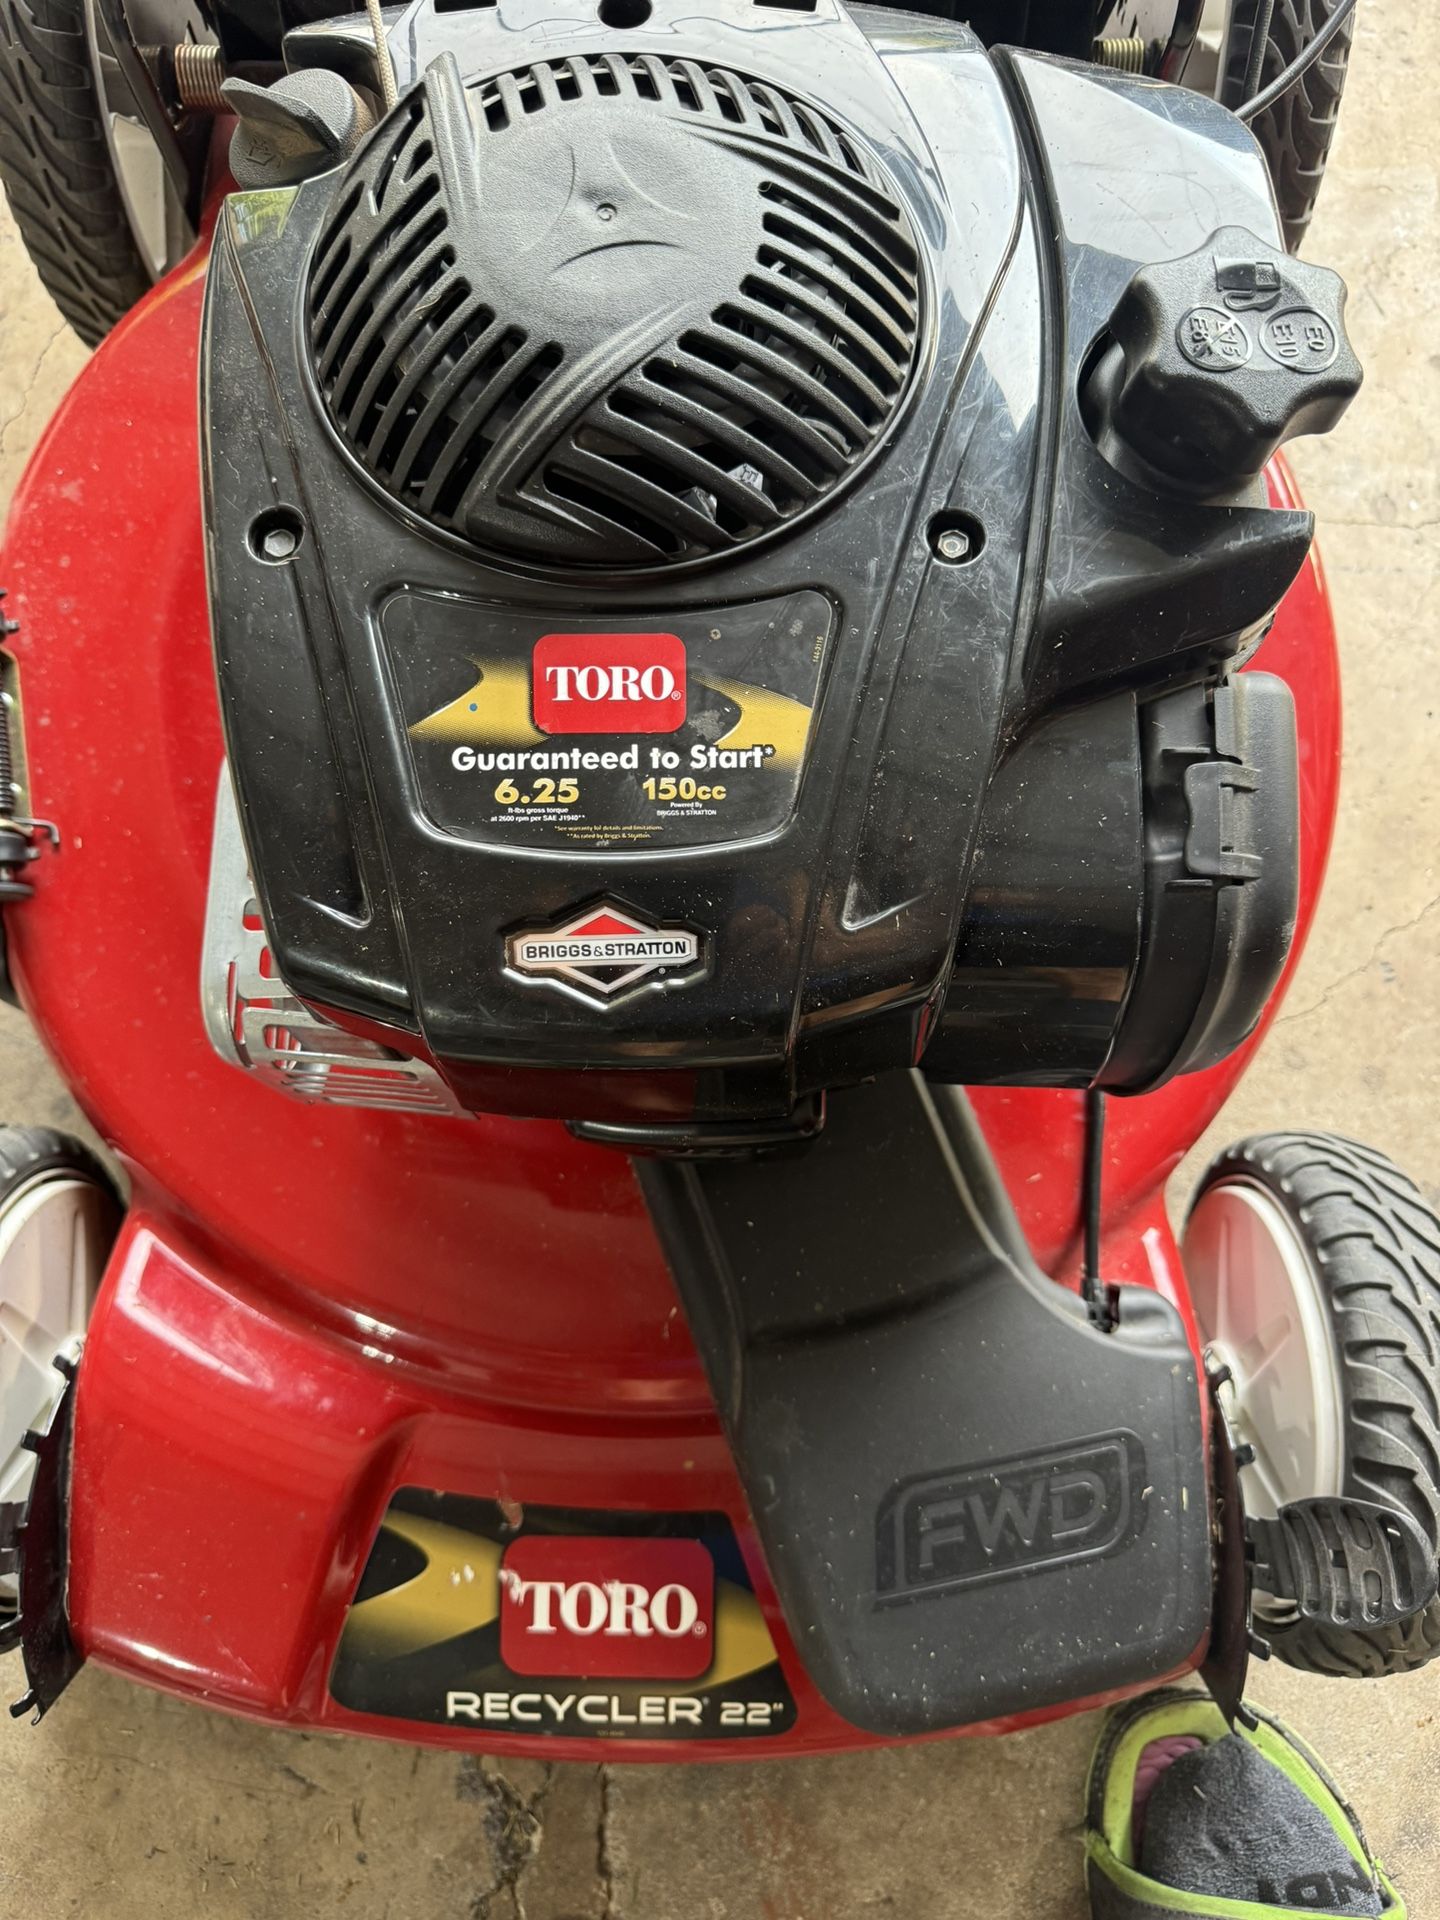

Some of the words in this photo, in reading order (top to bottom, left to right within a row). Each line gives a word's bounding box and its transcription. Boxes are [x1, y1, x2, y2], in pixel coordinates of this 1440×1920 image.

[1271, 323, 1300, 358] E10
[451, 745, 638, 771] Guaranteed
[651, 747, 679, 770] to
[494, 777, 580, 804] 6.25
[642, 777, 727, 801] 150cc
[526, 807, 545, 815] gross
[546, 807, 569, 815] torque
[919, 1470, 1107, 1569] FWD
[720, 1702, 784, 1726] 22"
